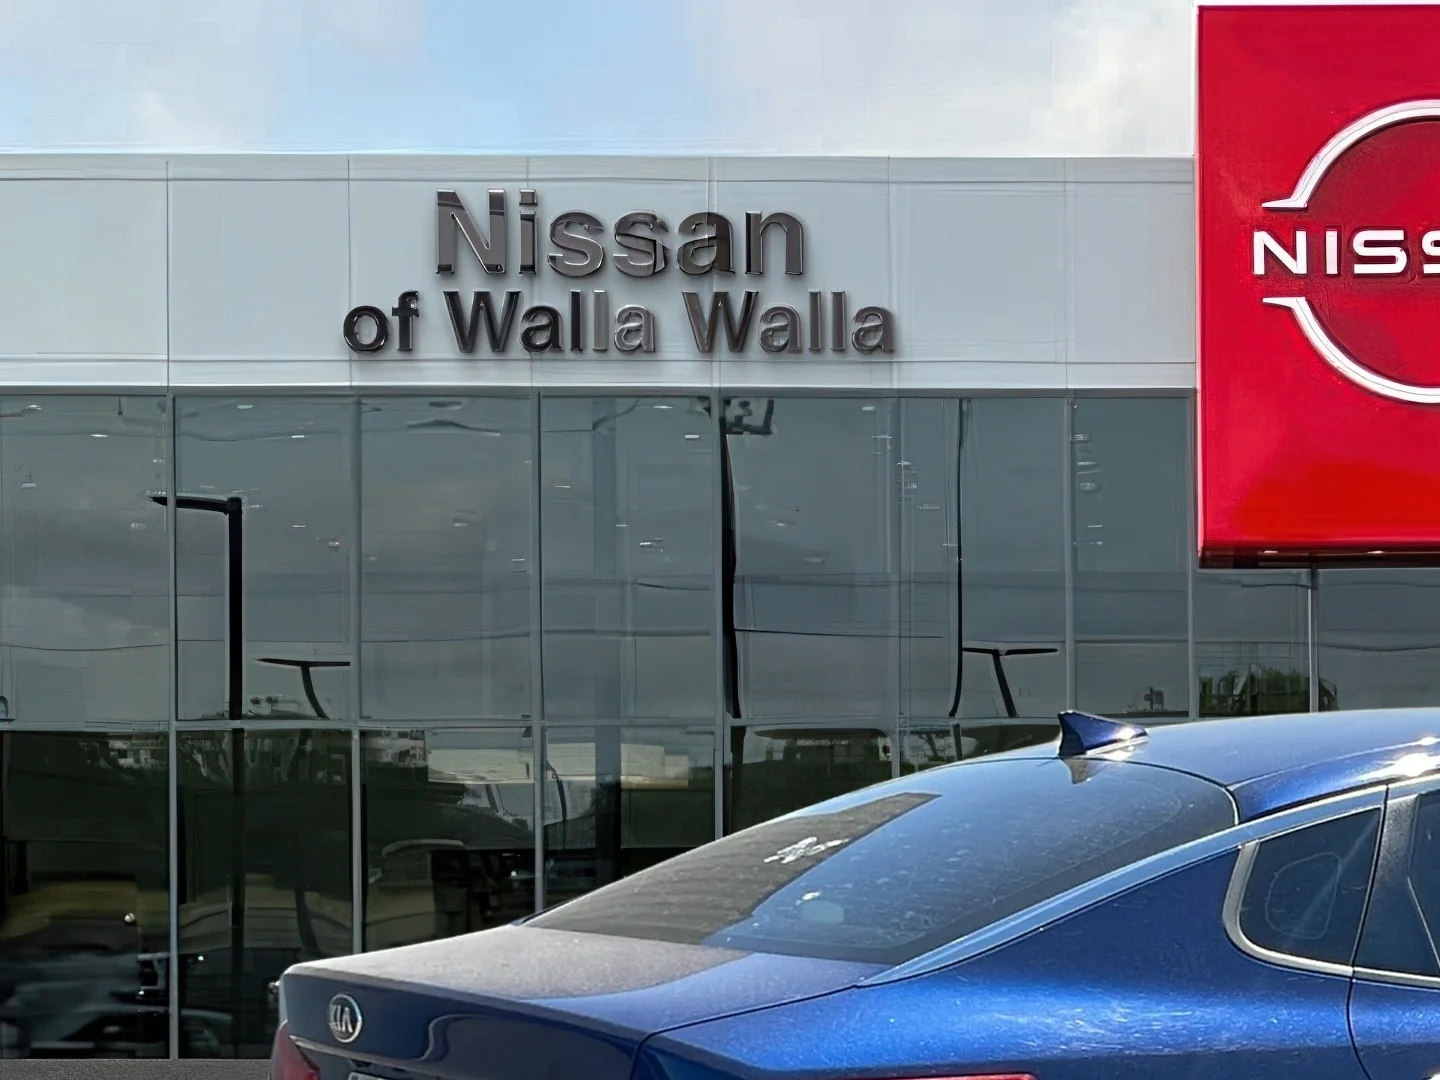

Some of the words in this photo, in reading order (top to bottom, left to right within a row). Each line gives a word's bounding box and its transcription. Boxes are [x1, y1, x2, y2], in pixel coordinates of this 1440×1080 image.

[435, 188, 806, 277] Nissan
[343, 290, 420, 353] of
[442, 289, 657, 354] Walla
[681, 289, 895, 354] Walla
[329, 1004, 354, 1033] KIA
